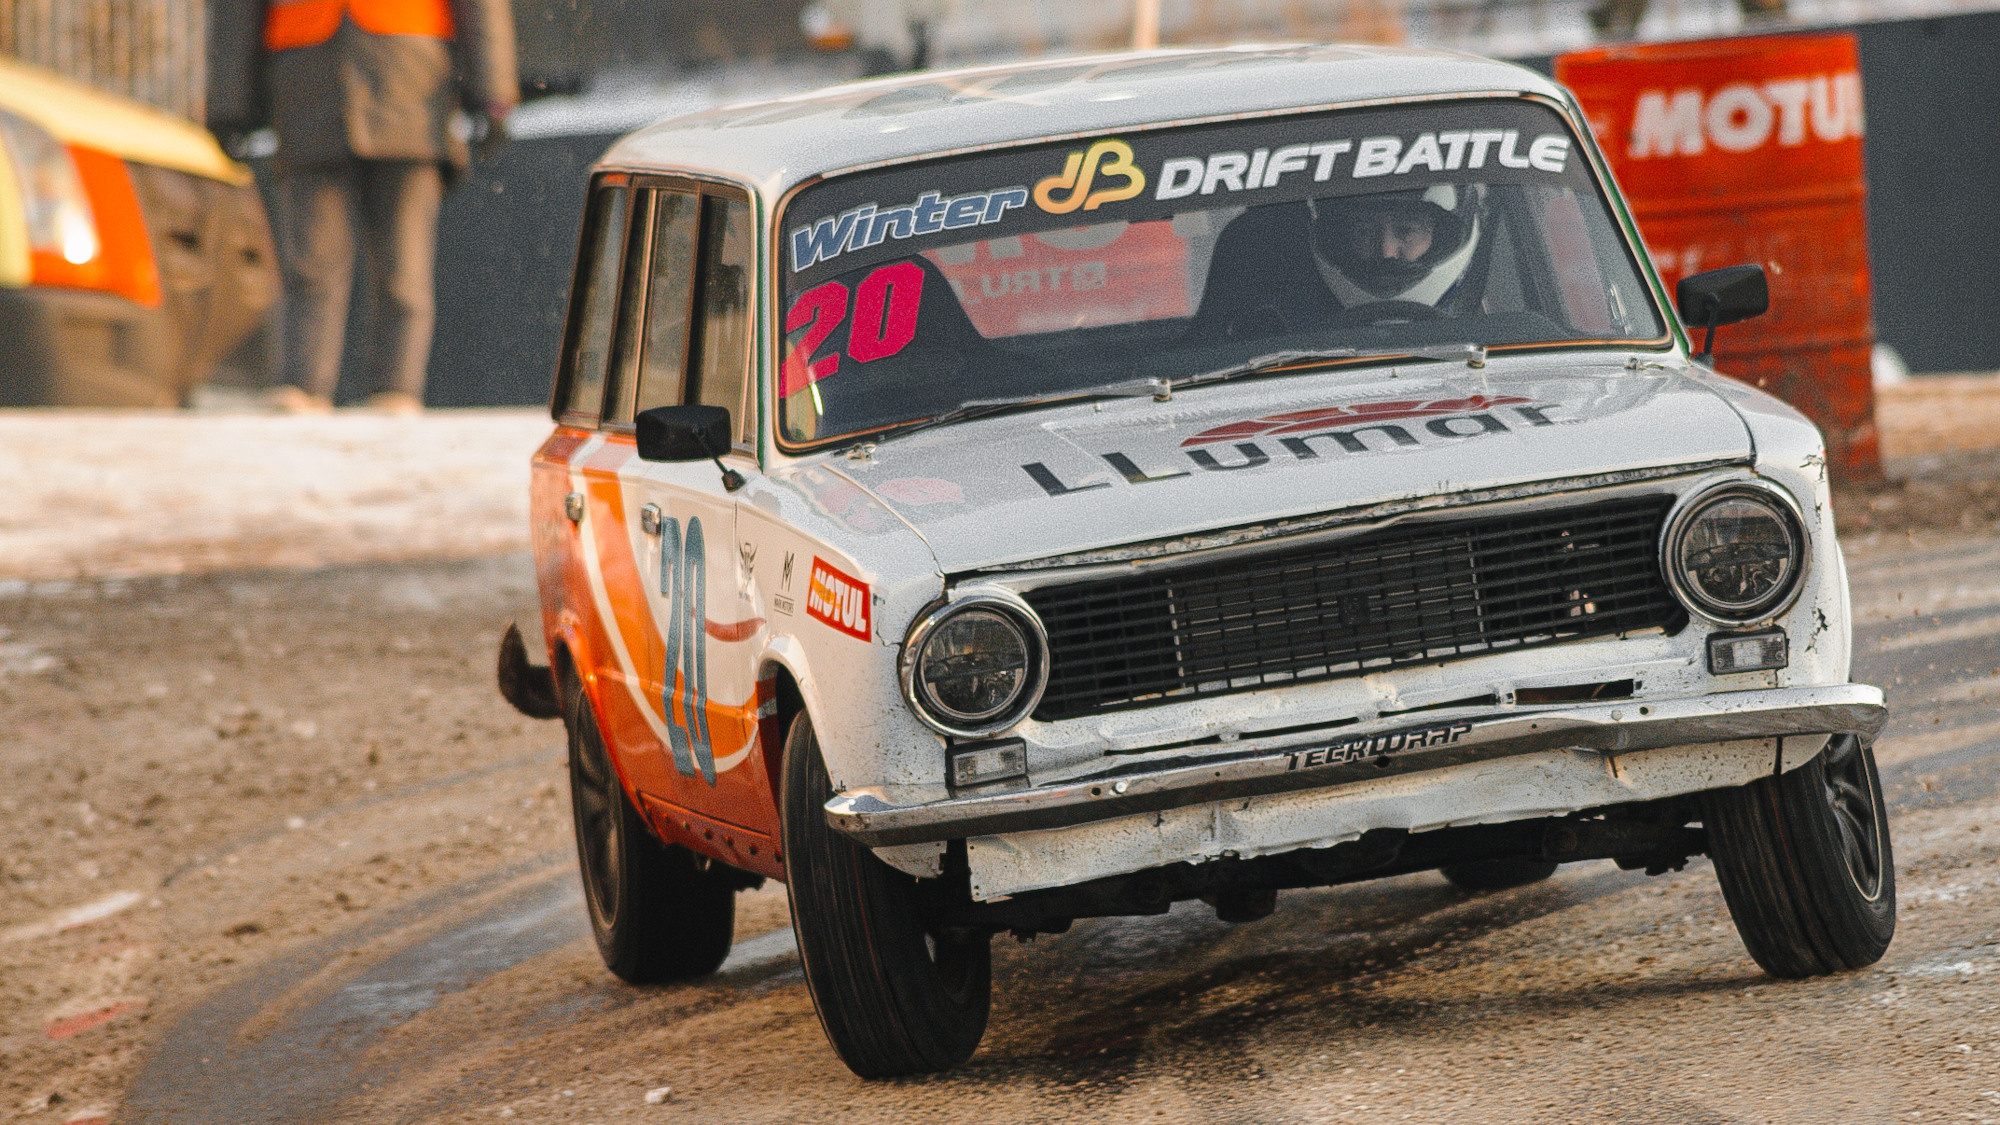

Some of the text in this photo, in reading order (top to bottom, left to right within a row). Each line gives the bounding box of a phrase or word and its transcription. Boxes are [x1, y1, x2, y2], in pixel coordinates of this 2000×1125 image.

[792, 188, 1028, 273] Winter
[1155, 142, 1351, 200] DRIFT
[1353, 130, 1571, 177] BATTLE
[780, 262, 924, 398] 20
[1021, 403, 1561, 498] LLumar
[661, 516, 717, 787] 20
[808, 566, 867, 632] MOTUL
[1284, 724, 1472, 770] TECKWRAP
